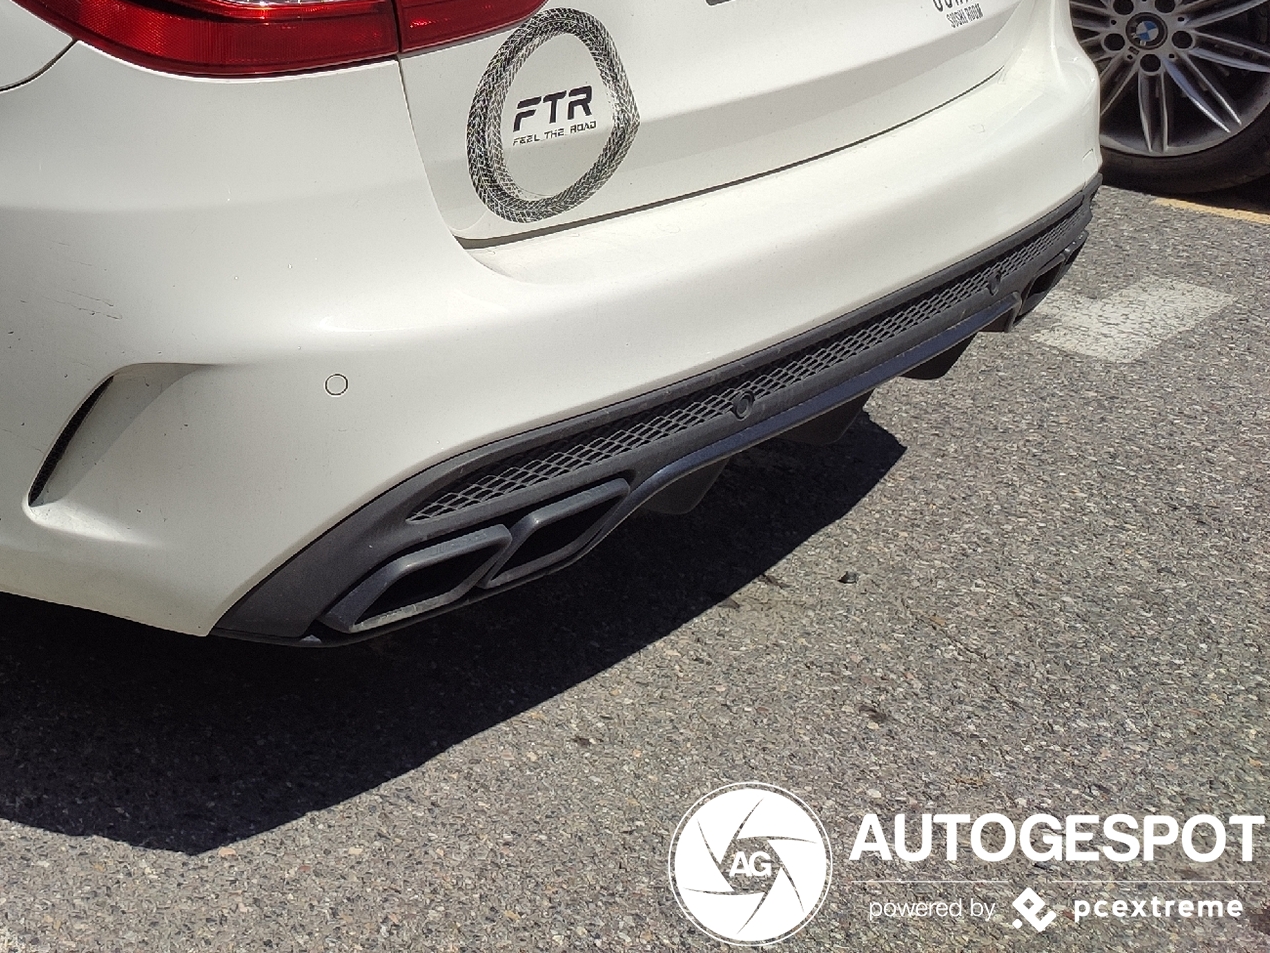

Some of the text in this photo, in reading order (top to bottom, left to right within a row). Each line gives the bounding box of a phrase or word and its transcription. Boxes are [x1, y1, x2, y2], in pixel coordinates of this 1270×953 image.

[512, 85, 592, 132] FTR
[512, 120, 597, 146] FEEL THE ROAD
